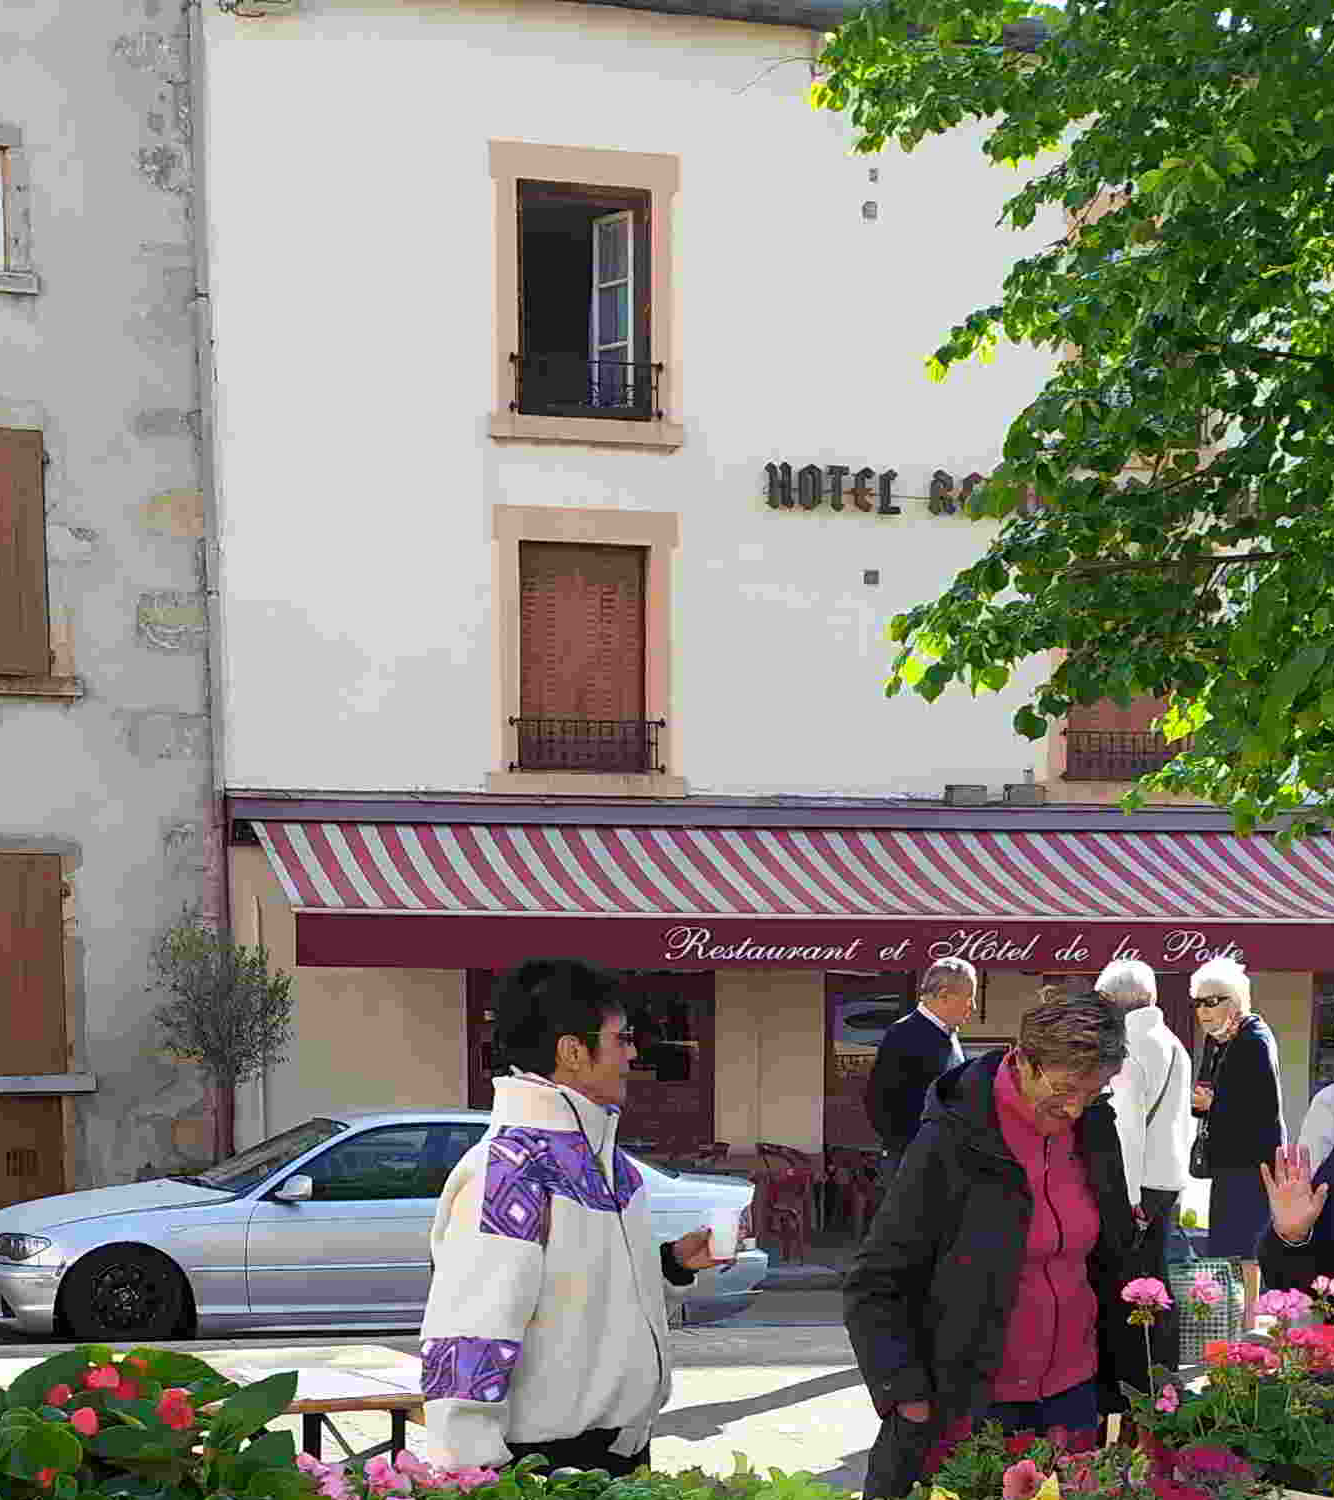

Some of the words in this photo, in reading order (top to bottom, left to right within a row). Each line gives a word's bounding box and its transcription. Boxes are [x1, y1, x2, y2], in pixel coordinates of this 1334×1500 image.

[764, 462, 902, 515] HOTEL
[664, 926, 863, 962] Restaurant
[879, 937, 914, 961] et
[928, 928, 1039, 963] Hôtel
[1054, 934, 1091, 962] de
[1111, 934, 1142, 962] la
[1162, 929, 1244, 962] Poste
